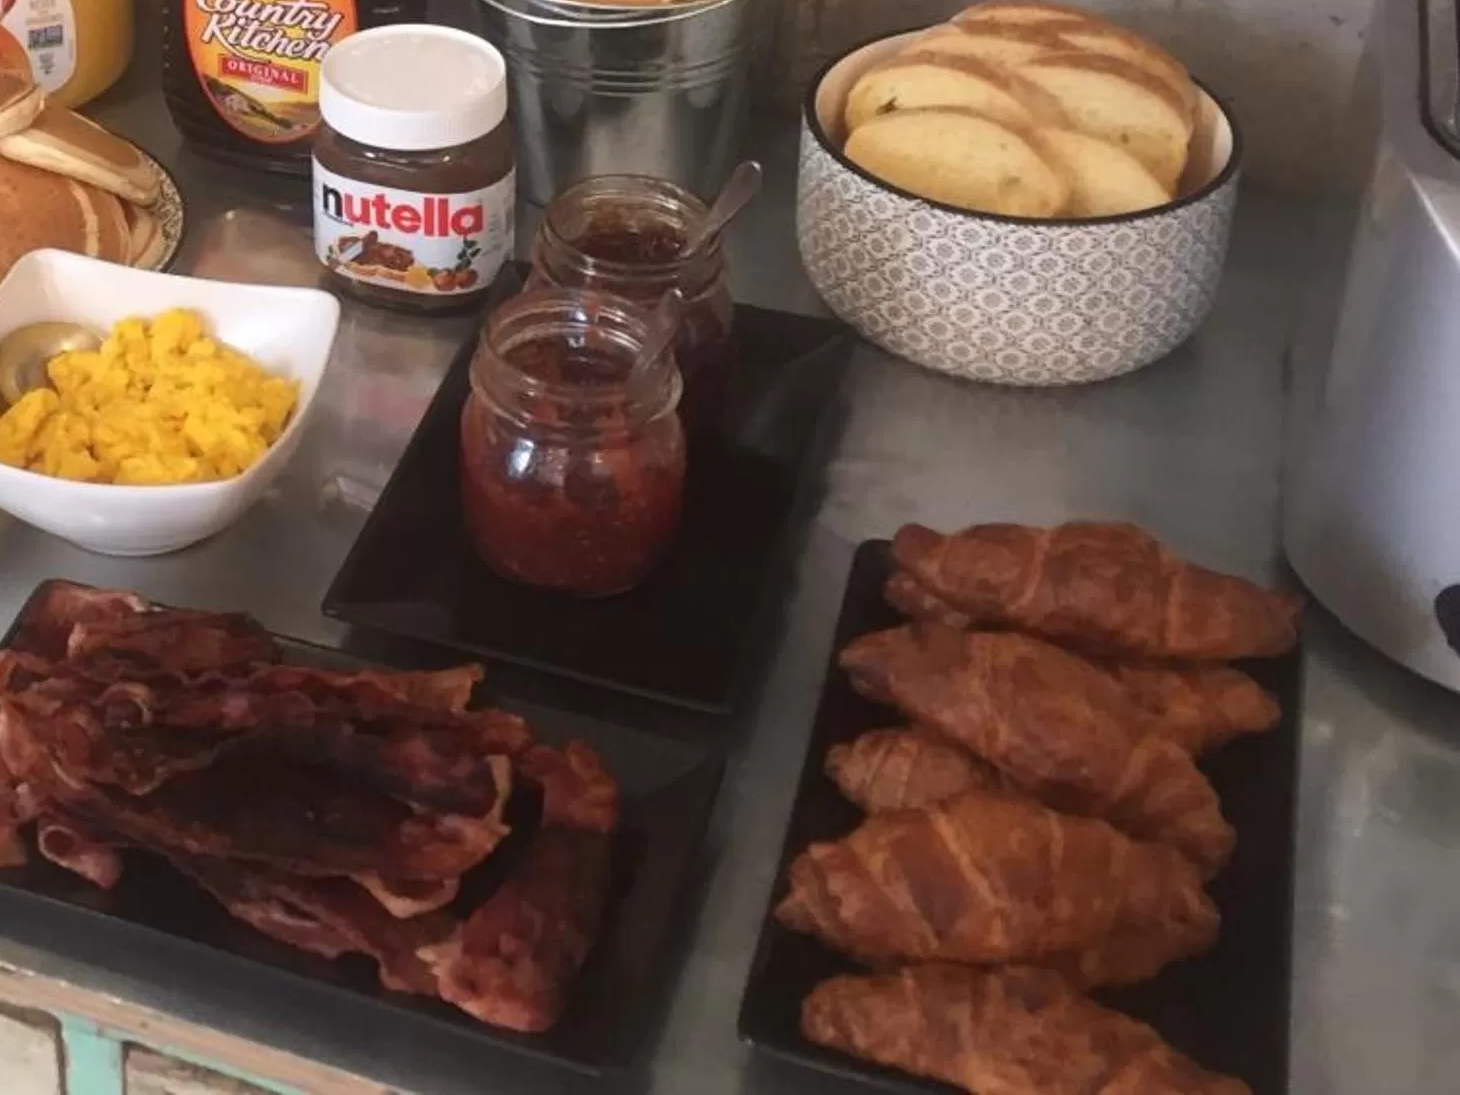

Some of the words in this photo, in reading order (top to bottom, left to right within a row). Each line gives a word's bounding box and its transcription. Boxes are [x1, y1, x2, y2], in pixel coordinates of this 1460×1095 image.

[201, 11, 333, 63] Kitchen
[226, 59, 303, 85] ORIGINAL
[322, 184, 484, 237] nutella
